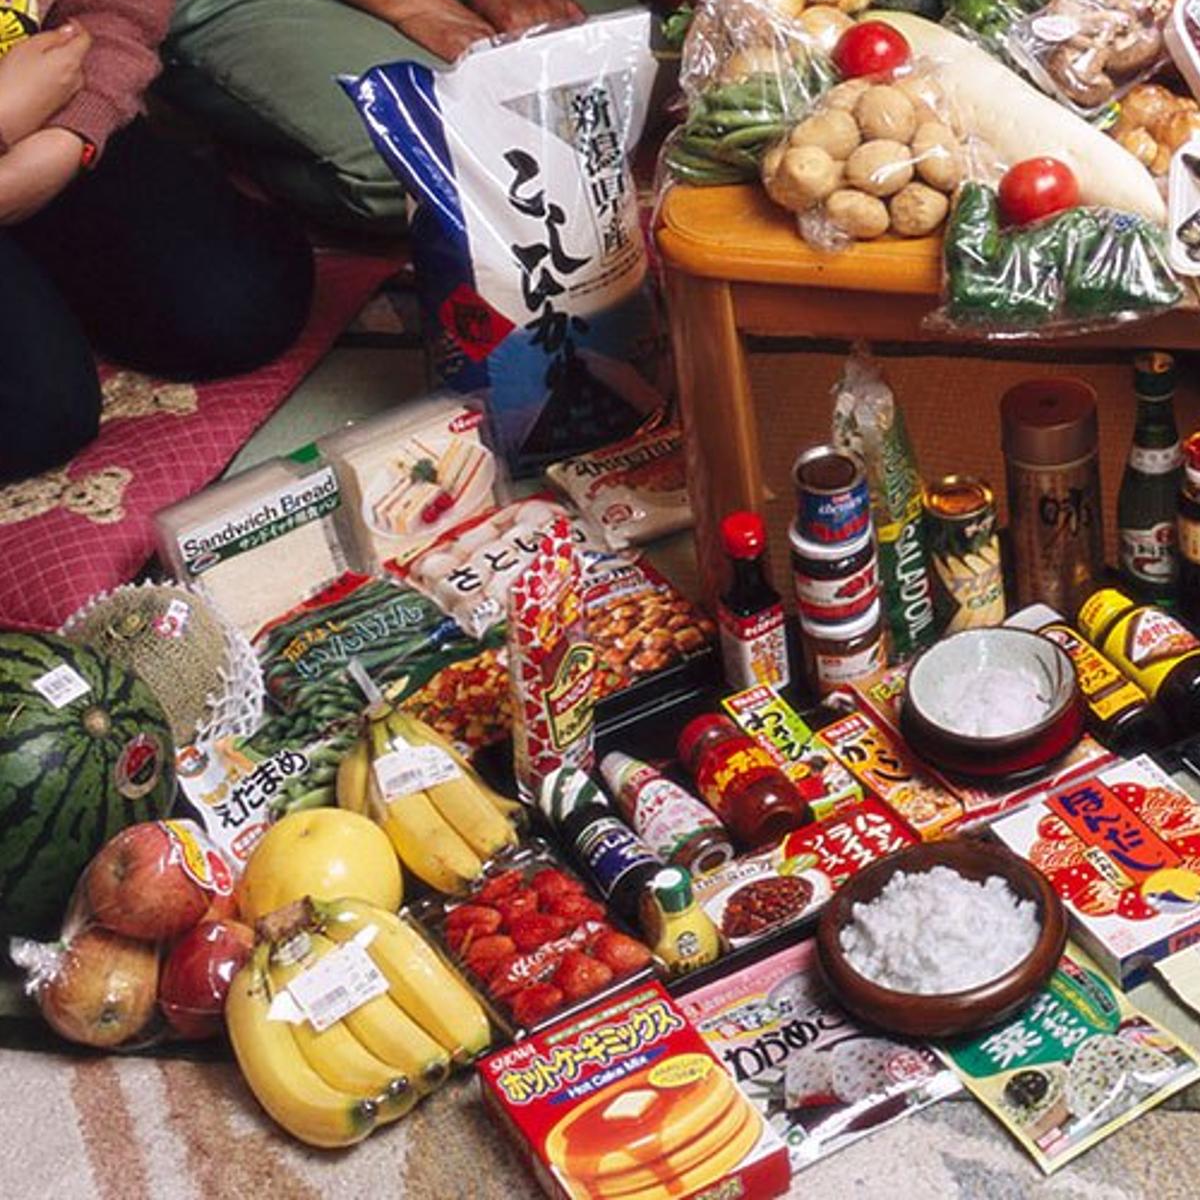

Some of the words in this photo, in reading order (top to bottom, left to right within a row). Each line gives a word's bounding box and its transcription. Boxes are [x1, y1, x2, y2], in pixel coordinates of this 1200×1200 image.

[183, 505, 278, 558] Sandwich
[280, 475, 335, 513] Bread
[895, 523, 929, 601] SALAD
[744, 710, 811, 762] わさび
[839, 737, 913, 781] からし
[211, 749, 311, 829] えだまめ
[825, 822, 876, 869] ライス
[1057, 786, 1167, 872] ほんだし
[500, 1002, 684, 1102] ホットケーキミックス
